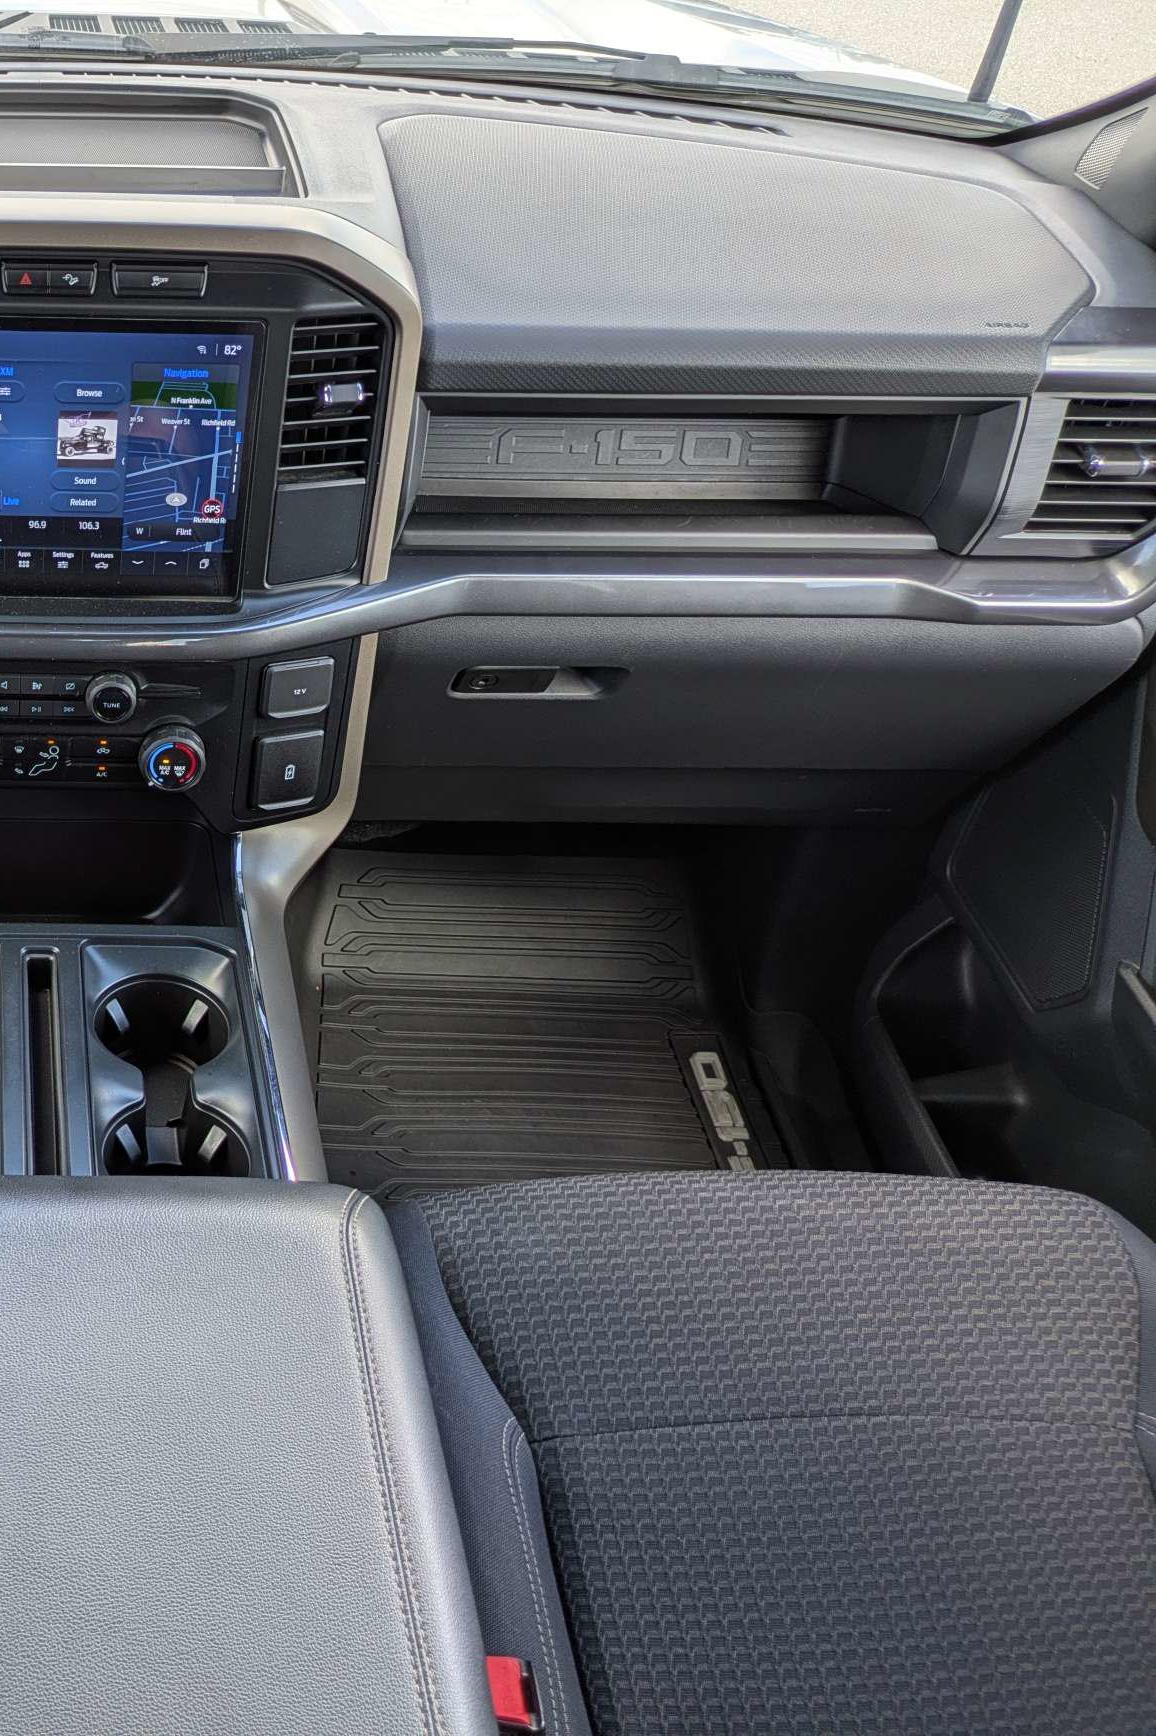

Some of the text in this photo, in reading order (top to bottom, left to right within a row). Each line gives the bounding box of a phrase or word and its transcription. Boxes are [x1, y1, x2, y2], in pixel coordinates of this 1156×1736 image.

[164, 368, 209, 378] Navigation
[76, 389, 103, 398] Browse
[496, 425, 744, 466] F-150
[74, 476, 96, 485] Sound
[4, 497, 20, 506] Live
[70, 498, 96, 506] Related
[204, 504, 220, 514] GPS
[28, 520, 46, 530] 96.9
[78, 522, 100, 530] 106.3
[176, 527, 192, 536] Flint
[52, 551, 74, 559] Settings
